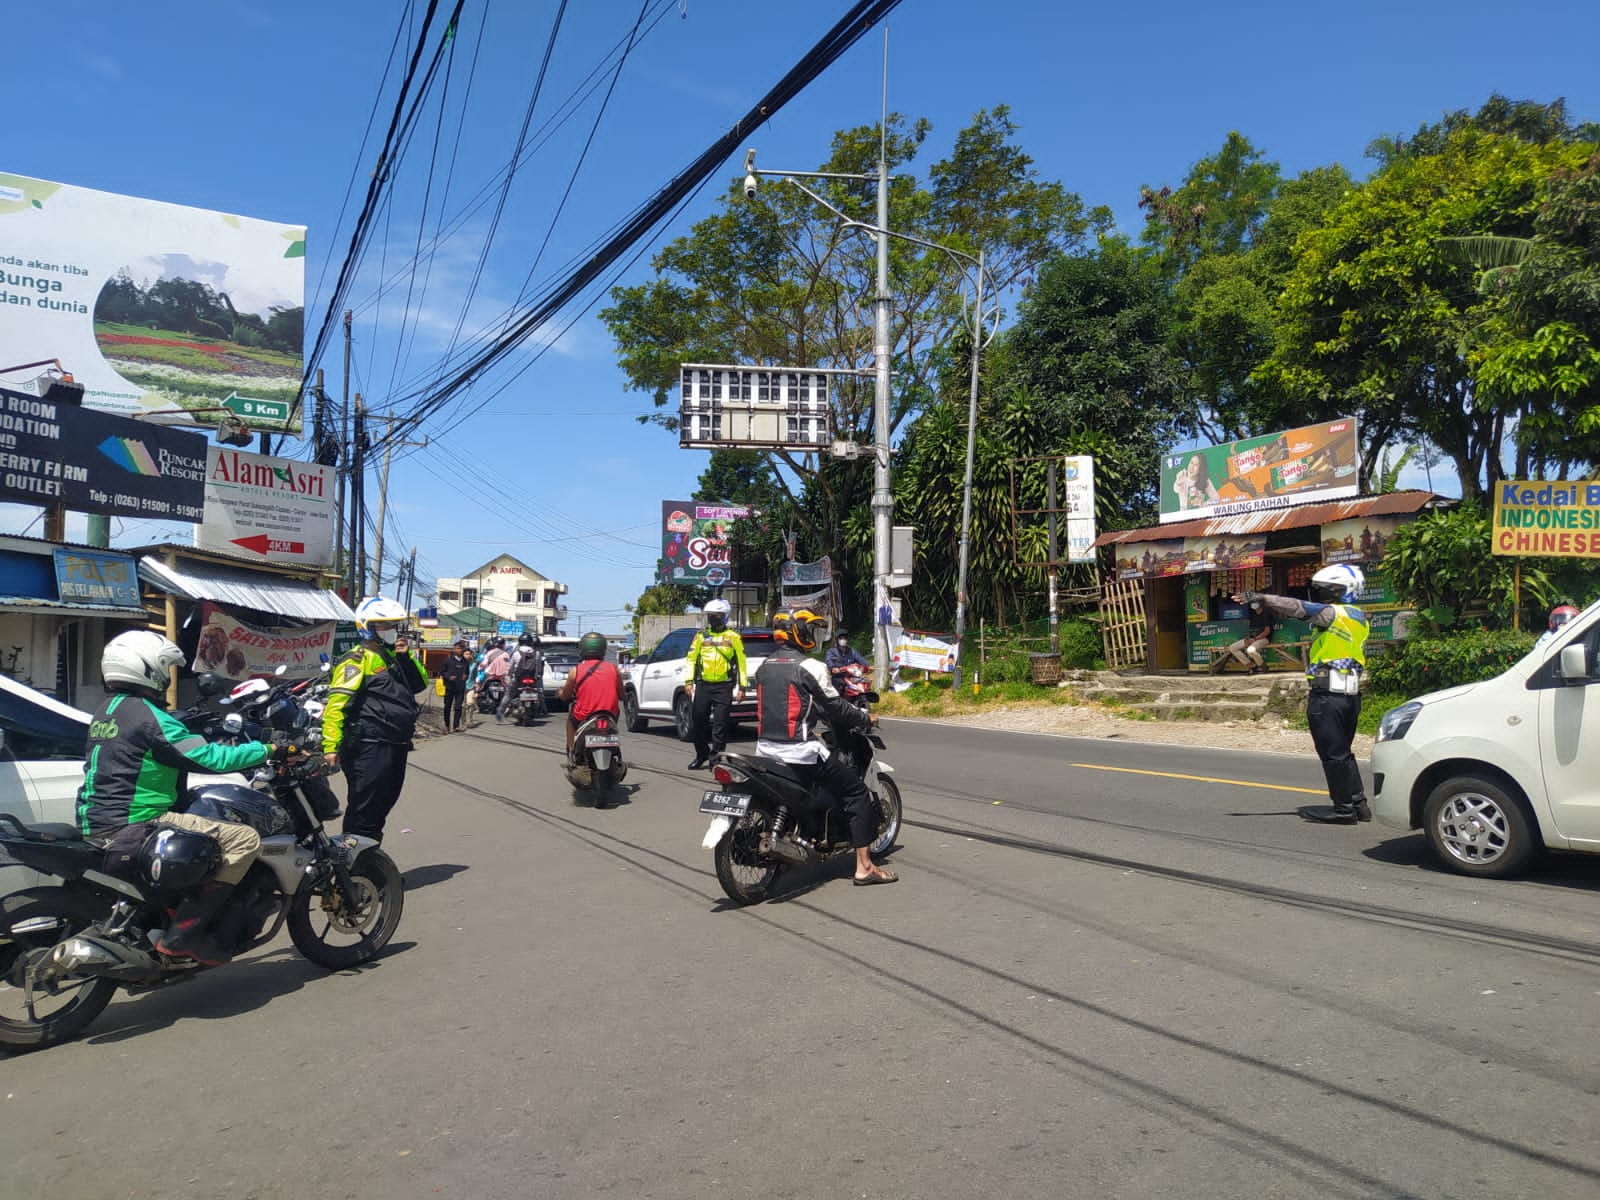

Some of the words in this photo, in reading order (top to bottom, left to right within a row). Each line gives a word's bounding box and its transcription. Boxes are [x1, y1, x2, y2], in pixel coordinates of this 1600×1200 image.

[27, 260, 60, 272] akan
[63, 264, 89, 276] tiba
[0, 290, 31, 307] dan
[37, 296, 88, 314] dunia
[8, 396, 56, 420] ROOM
[243, 402, 253, 413] 9
[256, 404, 279, 415] Km
[0, 413, 60, 440] DATION
[158, 447, 205, 470] PUNCAK
[1233, 452, 1262, 469] Tango
[44, 461, 88, 482] FARM
[160, 461, 205, 481] RESORT
[212, 450, 273, 488] Alam
[280, 463, 325, 497] Asri
[1279, 462, 1308, 480] Tango
[5, 473, 63, 497] OUTLET
[1502, 484, 1576, 507] Kedai
[89, 488, 107, 504] Telp
[114, 493, 140, 510] (0263)
[142, 499, 170, 512] 515001
[1213, 500, 1253, 515] WARUNG
[1254, 496, 1290, 510] RAIHAN
[1501, 508, 1600, 529] INDONESI
[269, 541, 292, 552] 4KM
[1500, 531, 1600, 554] CHINESE
[66, 556, 128, 583] POLISI
[89, 719, 119, 739] Grab
